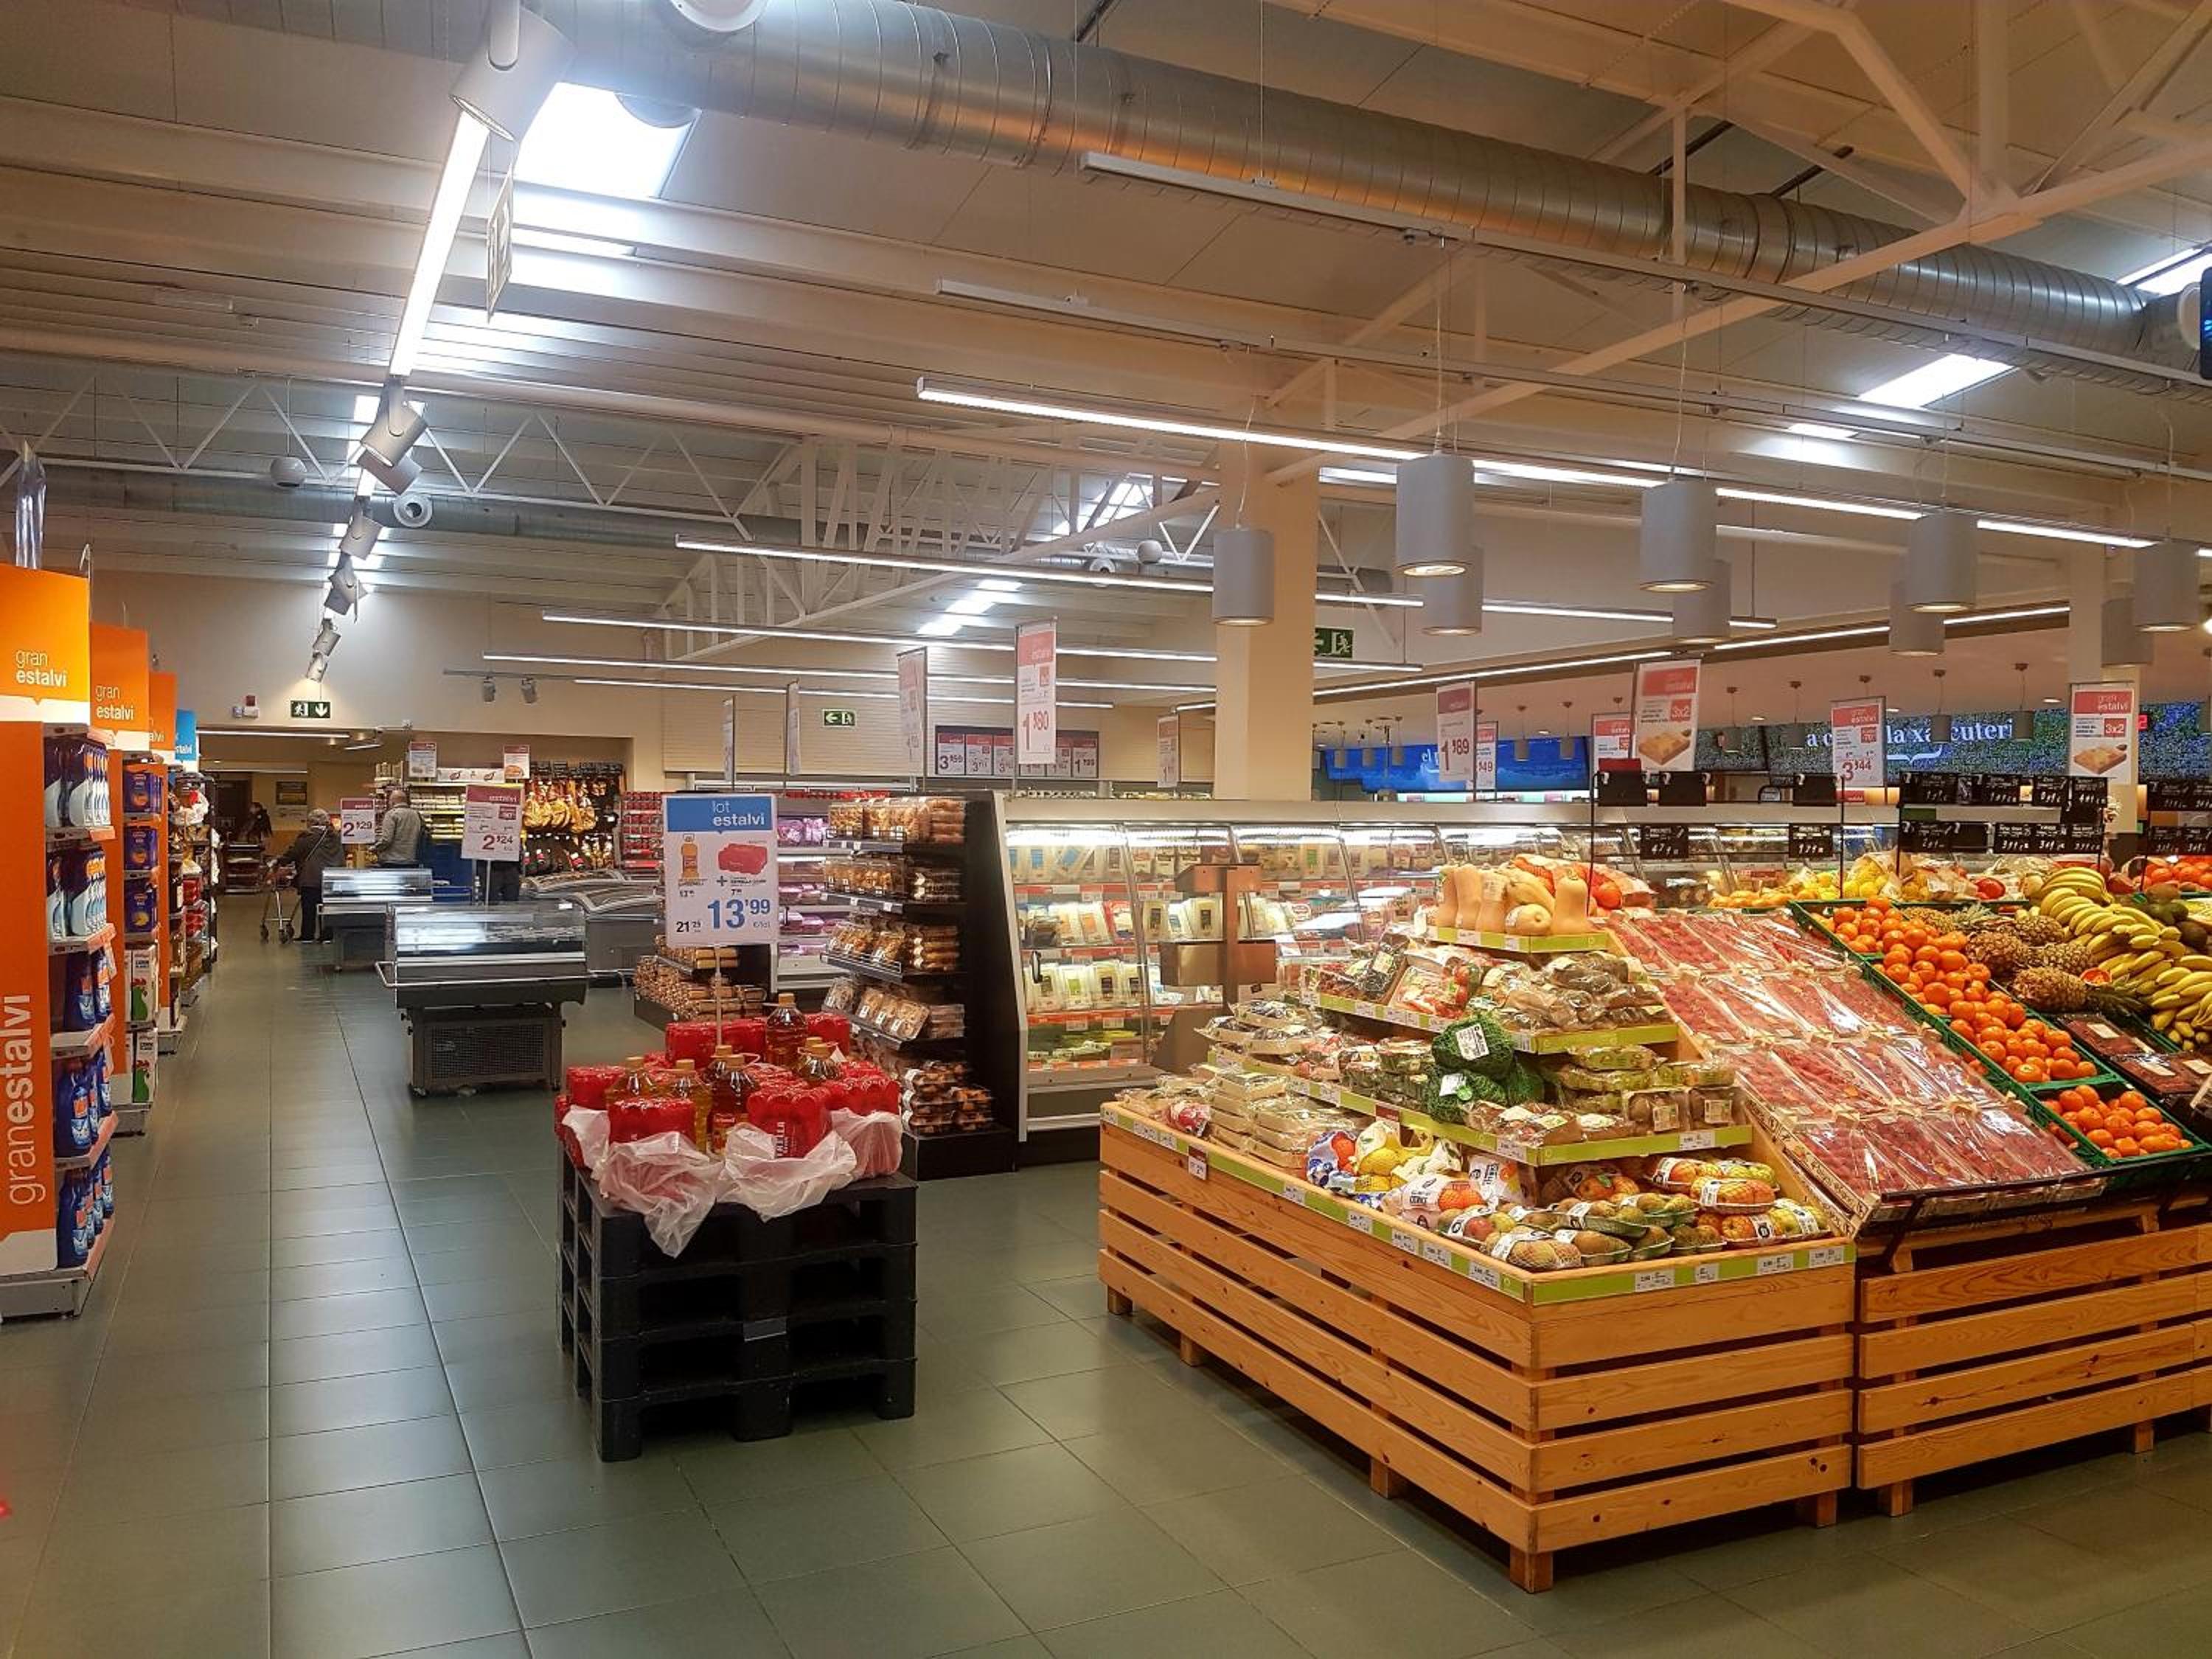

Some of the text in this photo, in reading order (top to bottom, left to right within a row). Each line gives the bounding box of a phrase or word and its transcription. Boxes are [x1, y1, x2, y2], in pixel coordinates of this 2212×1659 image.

[15, 649, 47, 668] gran
[16, 668, 67, 686] estalvi
[96, 686, 120, 701] gran
[97, 705, 134, 720] estalvi
[1670, 705, 1692, 719] 3x2
[2105, 723, 2124, 734] 3x2
[1441, 738, 1470, 771] 1'89
[712, 801, 730, 813] lot
[713, 813, 765, 827] estalvi
[482, 834, 514, 850] 2'24
[708, 898, 771, 930] 13'99
